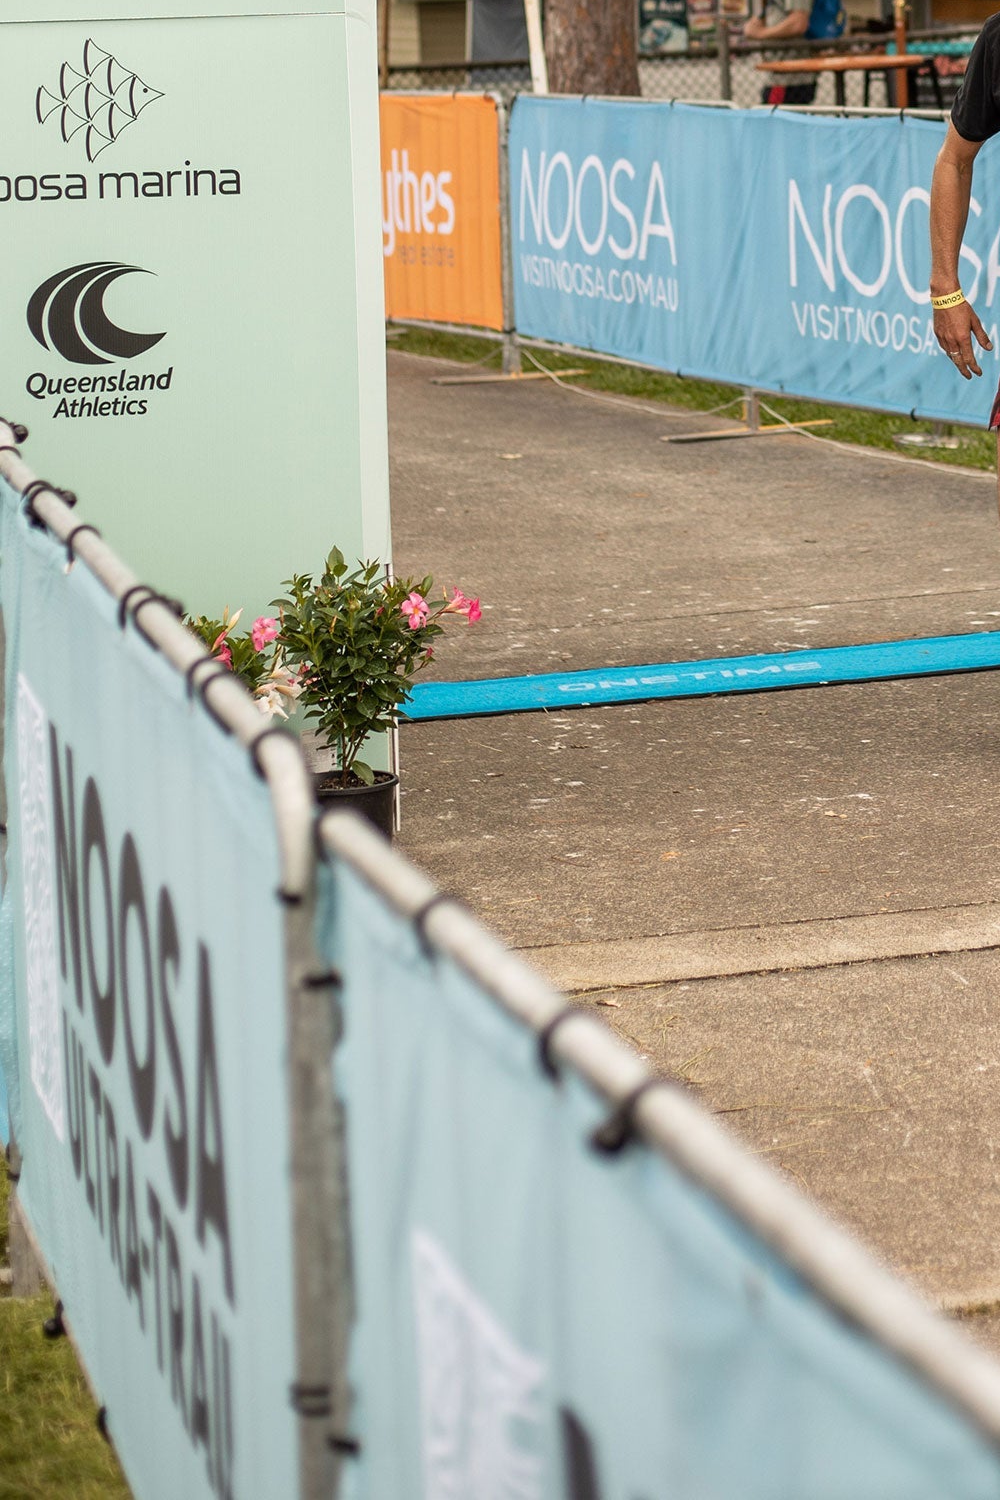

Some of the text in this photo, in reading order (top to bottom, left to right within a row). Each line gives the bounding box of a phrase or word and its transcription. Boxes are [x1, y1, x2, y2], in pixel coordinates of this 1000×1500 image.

[99, 160, 241, 199] marina
[519, 147, 677, 266] NOOSA
[26, 367, 173, 399] Queensland
[52, 396, 148, 419] Athletics
[558, 661, 822, 692] ONETIME
[49, 719, 236, 1316] NOOSA
